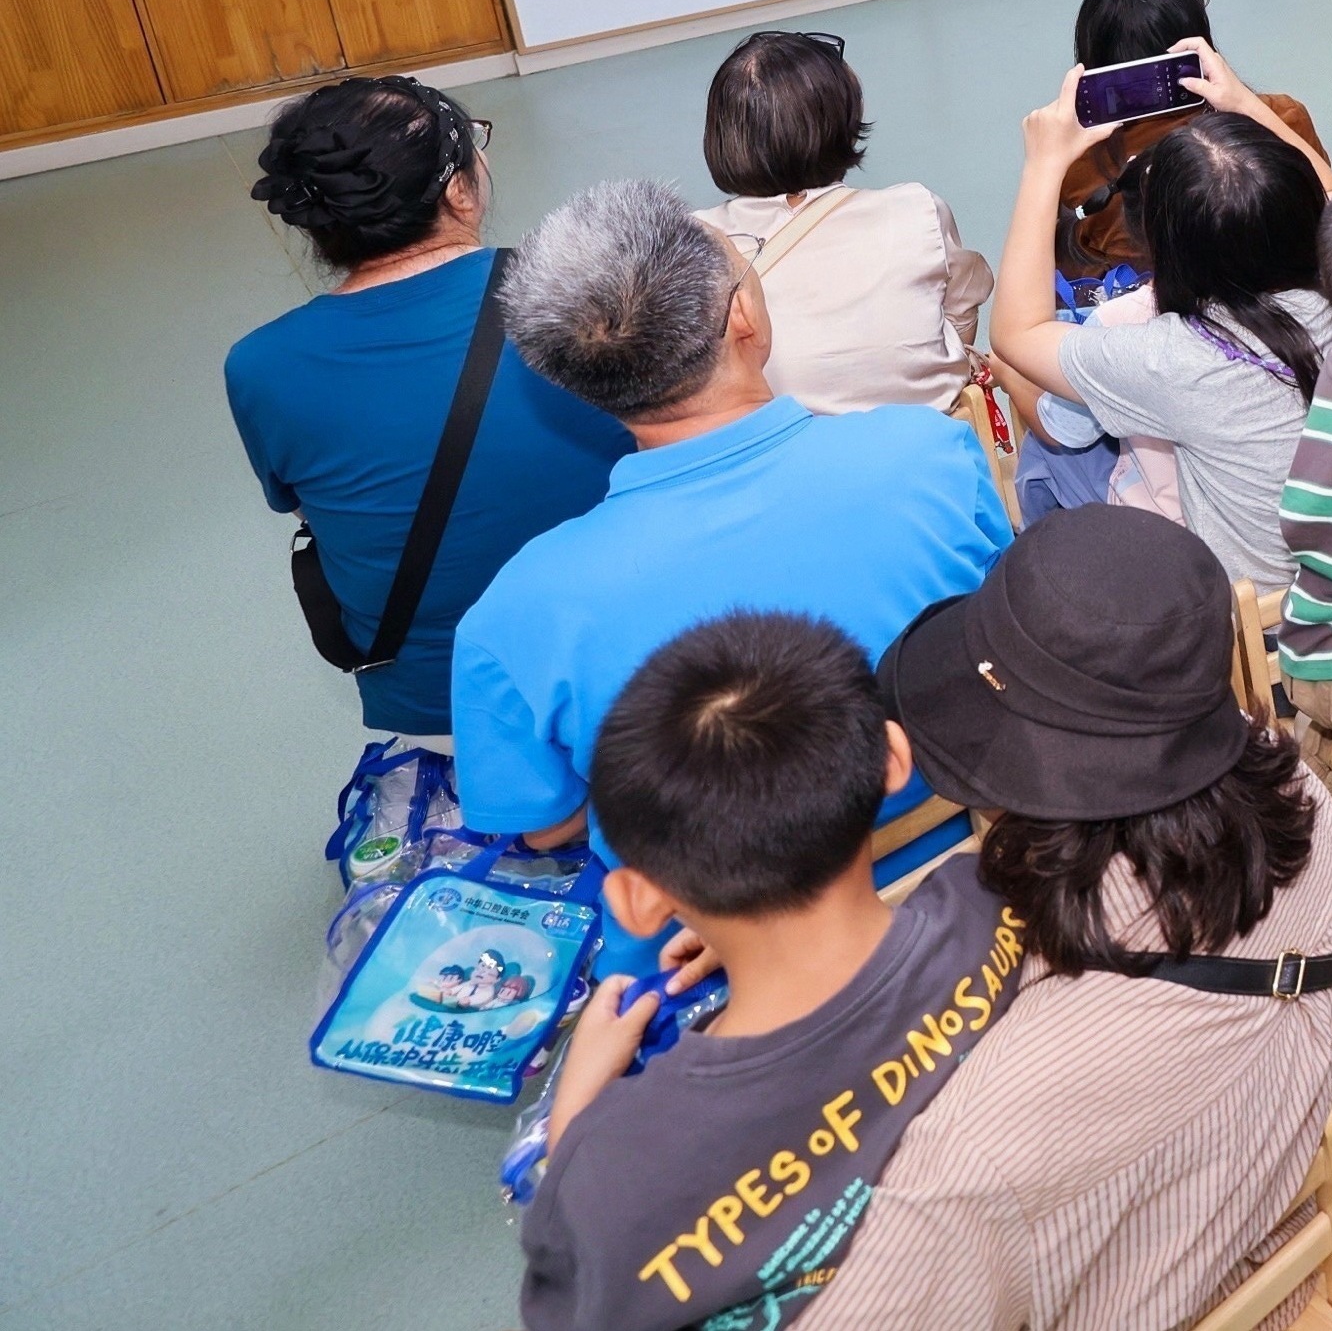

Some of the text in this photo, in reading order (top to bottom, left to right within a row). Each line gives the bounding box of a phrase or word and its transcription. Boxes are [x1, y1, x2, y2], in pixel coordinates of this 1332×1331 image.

[464, 896, 531, 920] 中华口腔医学会
[392, 1015, 508, 1055] 健康口腔
[638, 1150, 811, 1303] TYPES
